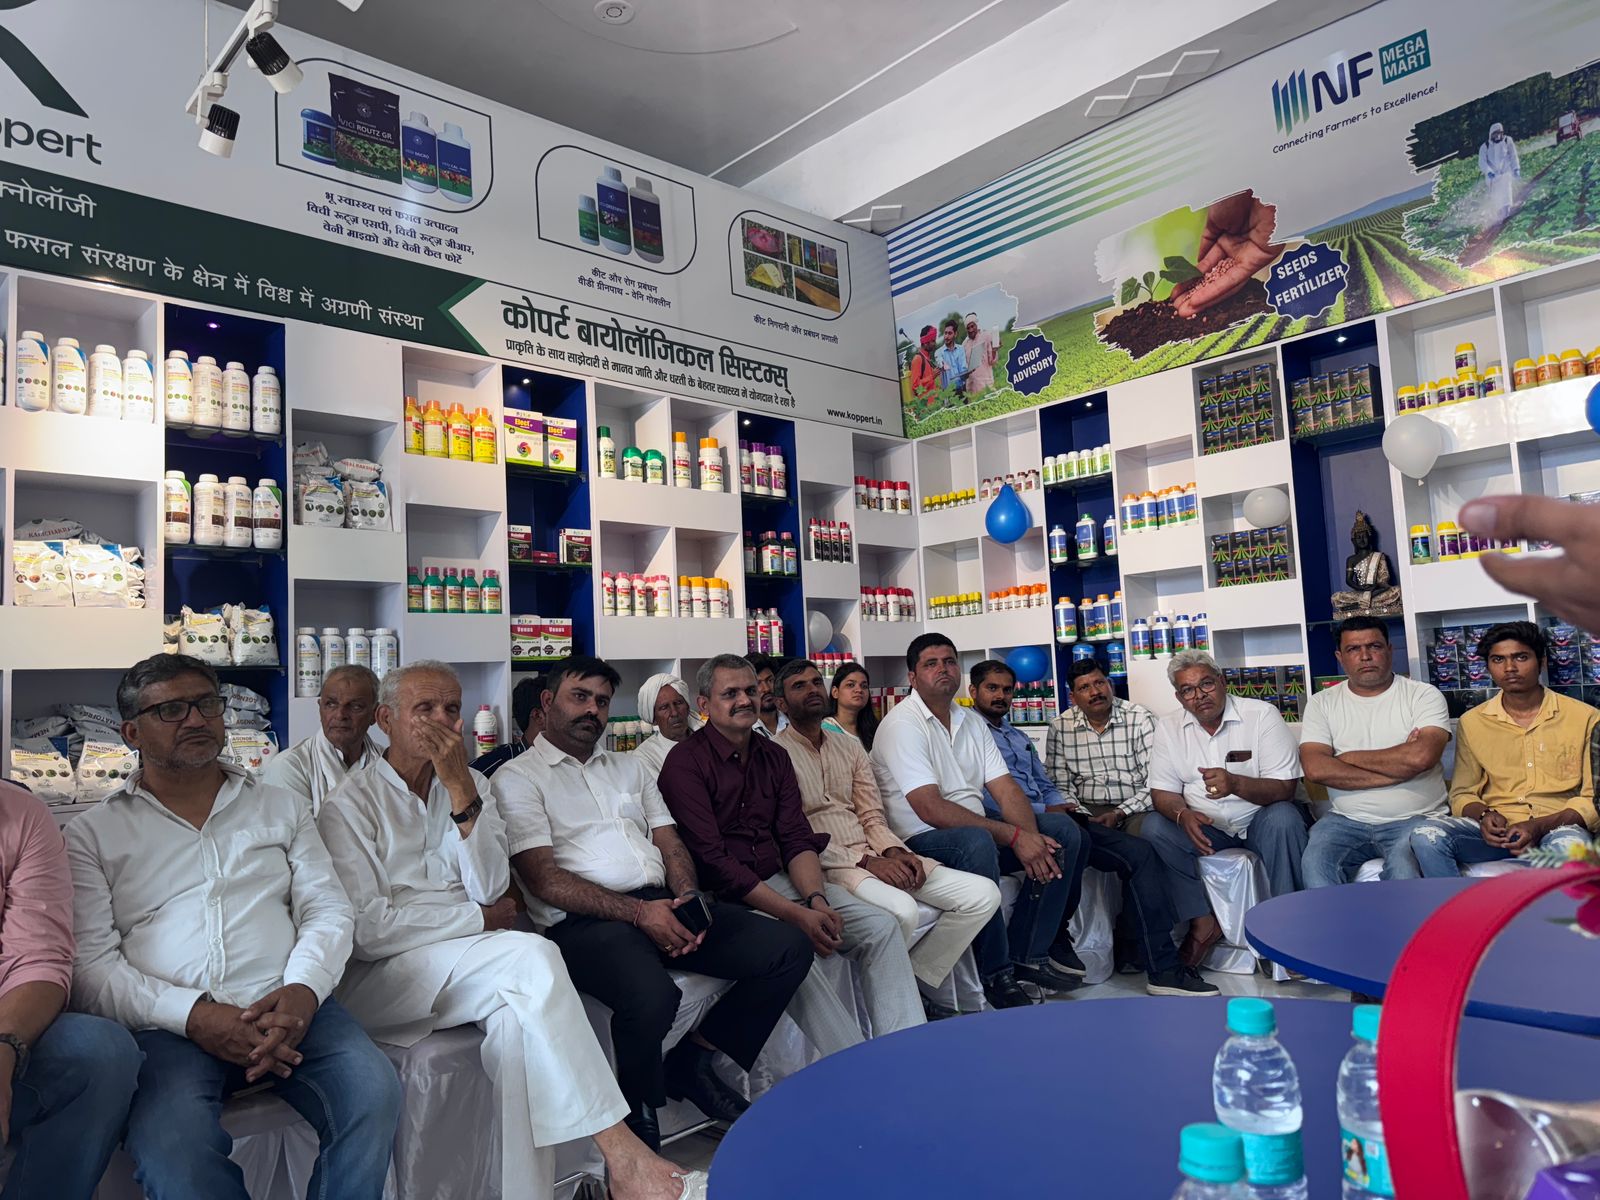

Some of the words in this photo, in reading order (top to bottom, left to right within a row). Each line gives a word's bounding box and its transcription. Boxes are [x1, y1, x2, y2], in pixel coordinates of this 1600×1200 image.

[1382, 35, 1426, 65] MEGA
[1384, 50, 1427, 80] MART
[1272, 128, 1323, 154] Connecting
[1325, 111, 1368, 134] Farmers
[1370, 105, 1382, 116] to
[1384, 82, 1439, 111] Excellence!
[0, 117, 102, 166] pert
[382, 236, 399, 249] और
[4, 229, 73, 260] फसल
[81, 243, 156, 277] संरक्षण
[163, 257, 185, 281] के
[192, 264, 228, 291] क्षेत्र
[234, 272, 250, 295] में
[257, 277, 293, 304] विश्व
[300, 286, 315, 309] में
[321, 299, 373, 321] अग्रणी
[377, 306, 425, 331] संस्था
[1276, 250, 1318, 280] SEEDS
[1298, 271, 1306, 281] &
[1275, 264, 1345, 307] FERTILIZER
[500, 294, 571, 340] कोपर्ट
[575, 316, 715, 373] बायोलॉजिकल
[1012, 354, 1054, 385] ADVISORY
[1017, 347, 1041, 366] CROP
[826, 408, 883, 426] www.koppert.in
